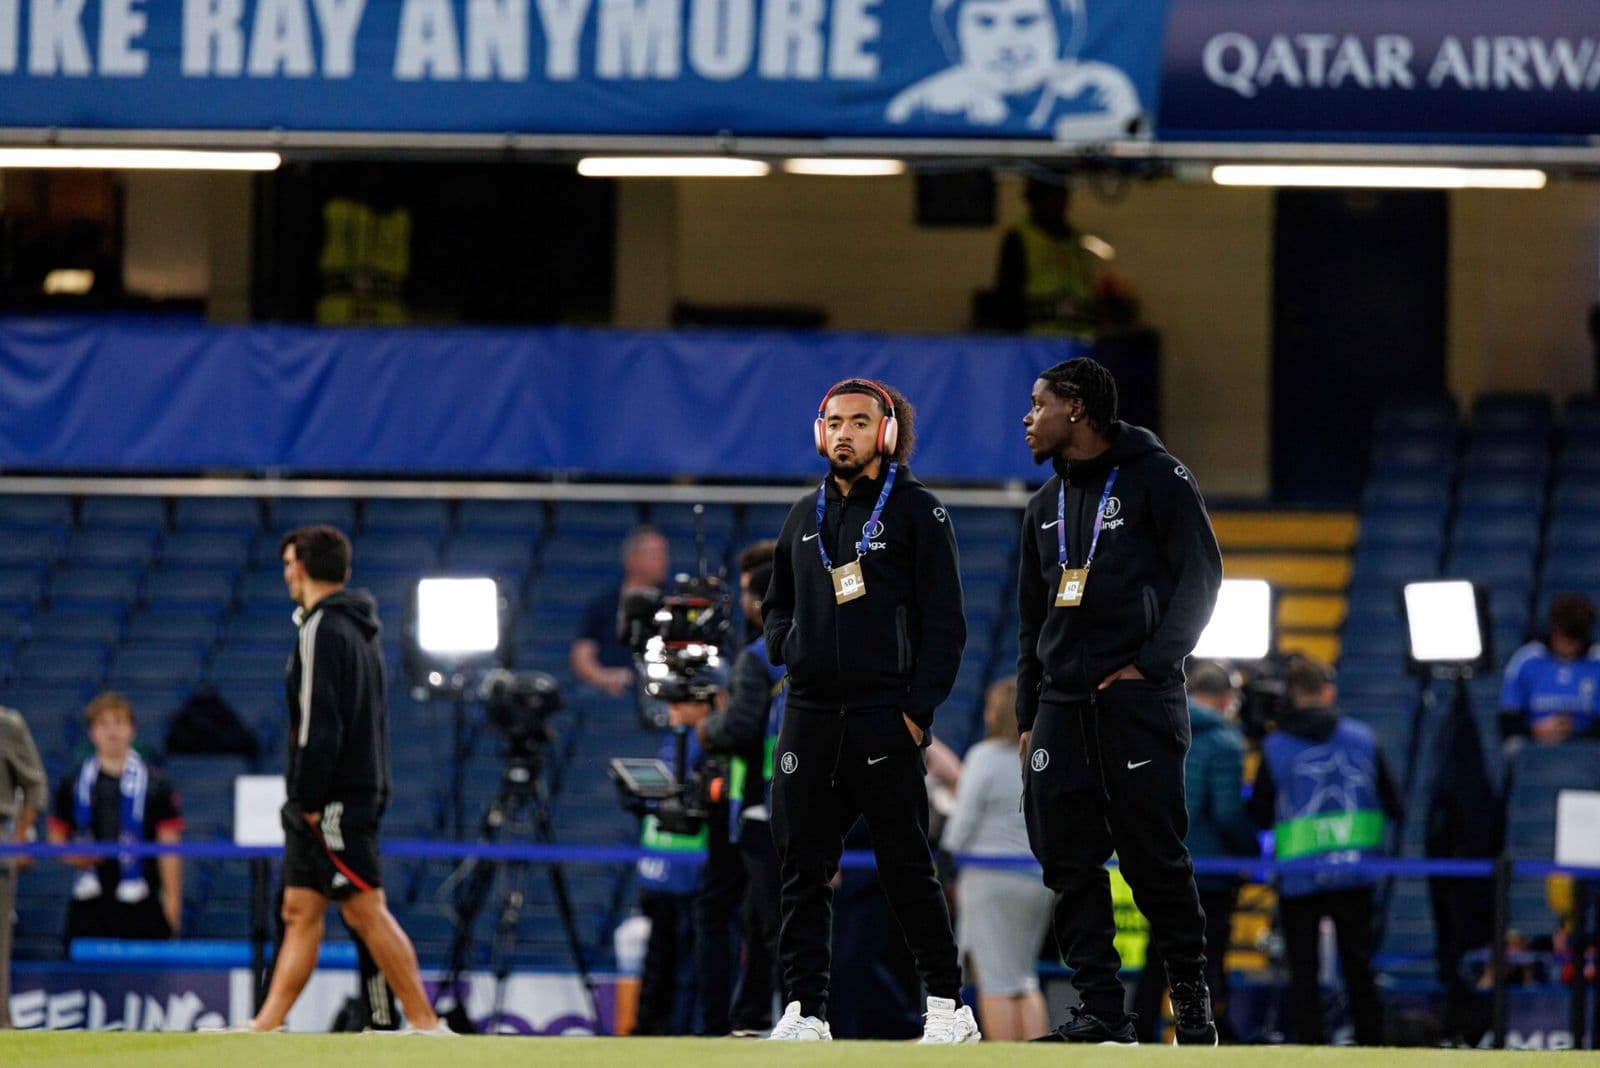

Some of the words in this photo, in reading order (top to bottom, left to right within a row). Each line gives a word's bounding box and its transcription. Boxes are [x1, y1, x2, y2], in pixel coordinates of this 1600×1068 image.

[182, 0, 366, 76] RAY
[395, 0, 880, 79] ANYMORE
[1203, 32, 1414, 98] QATAR
